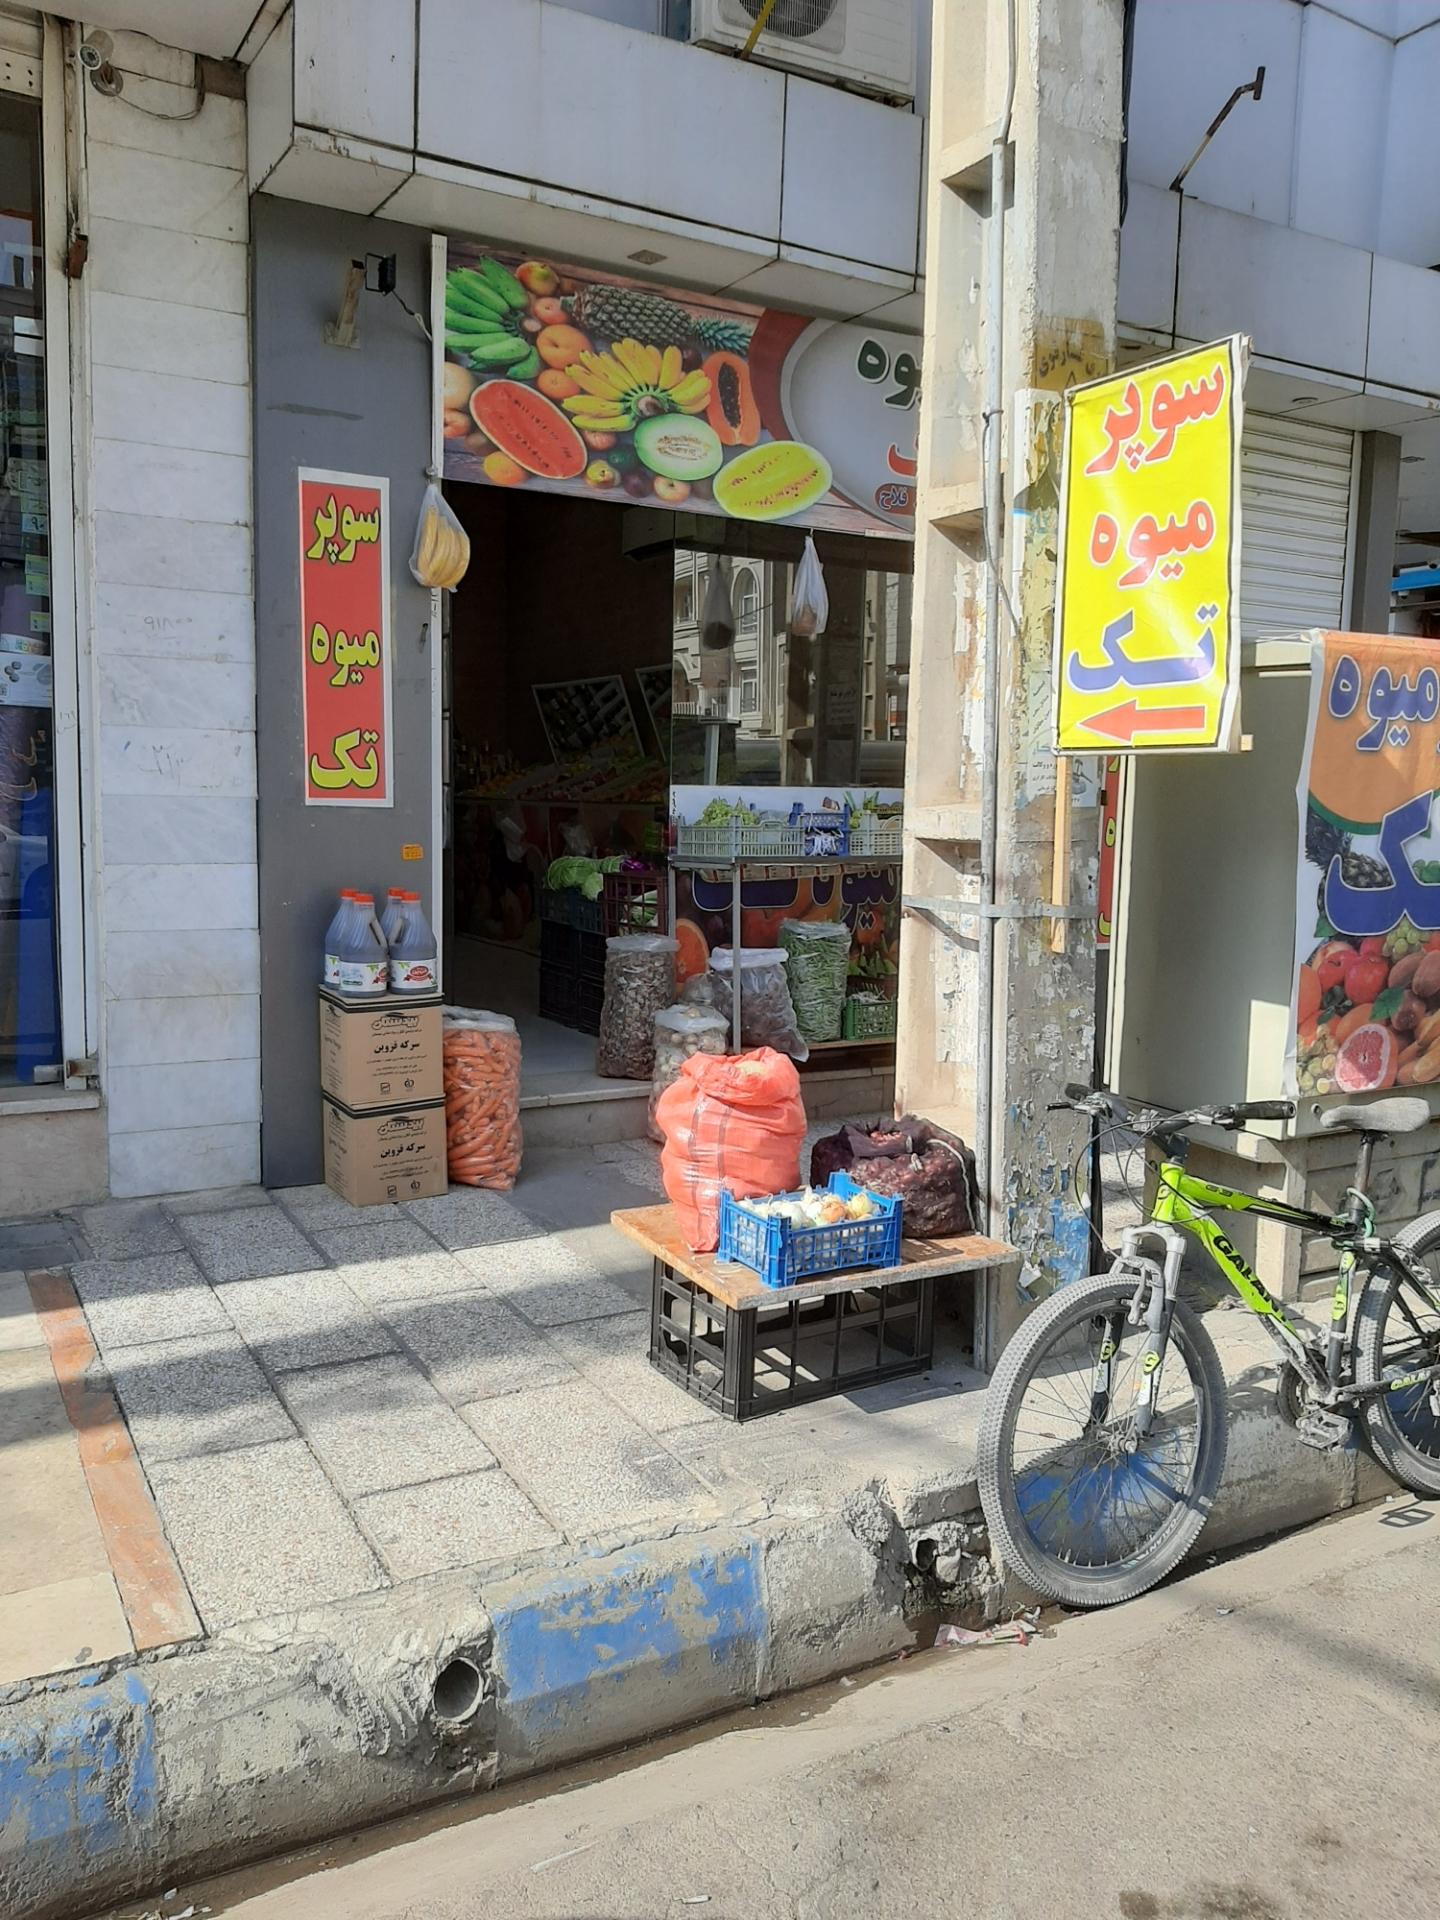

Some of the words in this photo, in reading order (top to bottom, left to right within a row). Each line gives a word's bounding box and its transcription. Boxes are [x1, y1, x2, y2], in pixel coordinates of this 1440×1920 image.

[856, 336, 923, 411] وه
[1084, 365, 1226, 476] سوپر
[306, 493, 381, 565] سوپر
[879, 485, 908, 510] فلاح
[1089, 499, 1216, 588] میوه
[310, 621, 381, 687] میوه
[1066, 602, 1221, 694] تک
[1328, 655, 1440, 751] میوه
[309, 728, 380, 790] تک
[1324, 789, 1440, 936] ک
[373, 1041, 398, 1054] قزوین
[400, 1039, 420, 1051] سرکه
[380, 1146, 404, 1159] قزوین
[406, 1143, 426, 1154] سرکه
